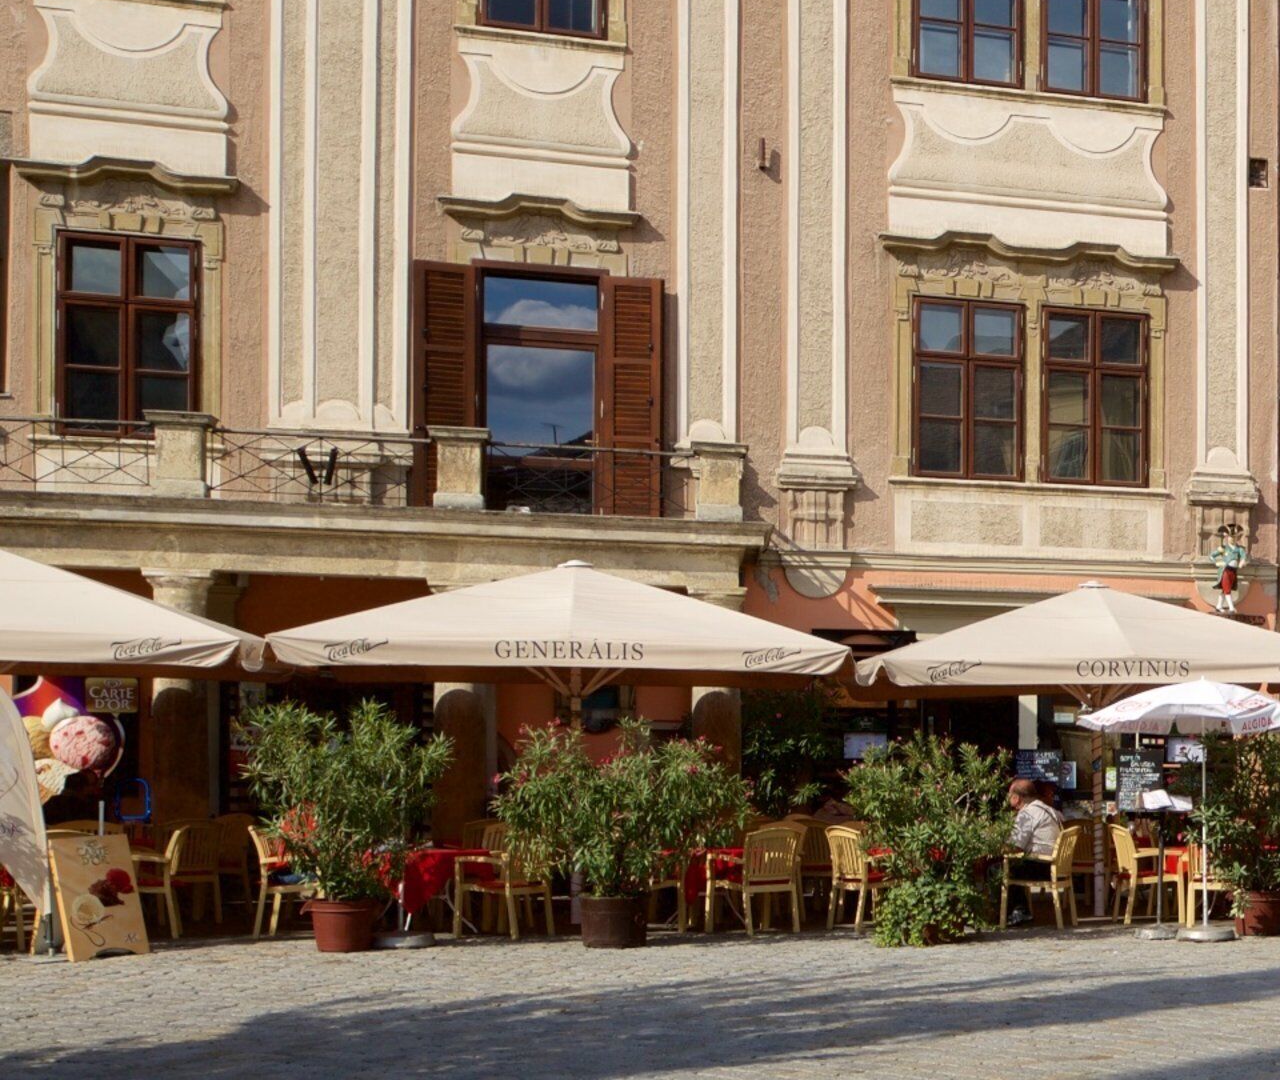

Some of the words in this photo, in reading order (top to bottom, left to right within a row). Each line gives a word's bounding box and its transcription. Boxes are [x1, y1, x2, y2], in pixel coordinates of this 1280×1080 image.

[111, 637, 182, 661] Coca-Cola
[324, 638, 389, 662] Coca-Cola
[494, 638, 644, 661] GENERÁLIS
[742, 647, 802, 668] Coca-Cola
[1076, 660, 1190, 677] CORVINUS
[89, 686, 134, 700] CARTE
[95, 699, 131, 711] D'OR
[1241, 716, 1273, 731] ALGIDA
